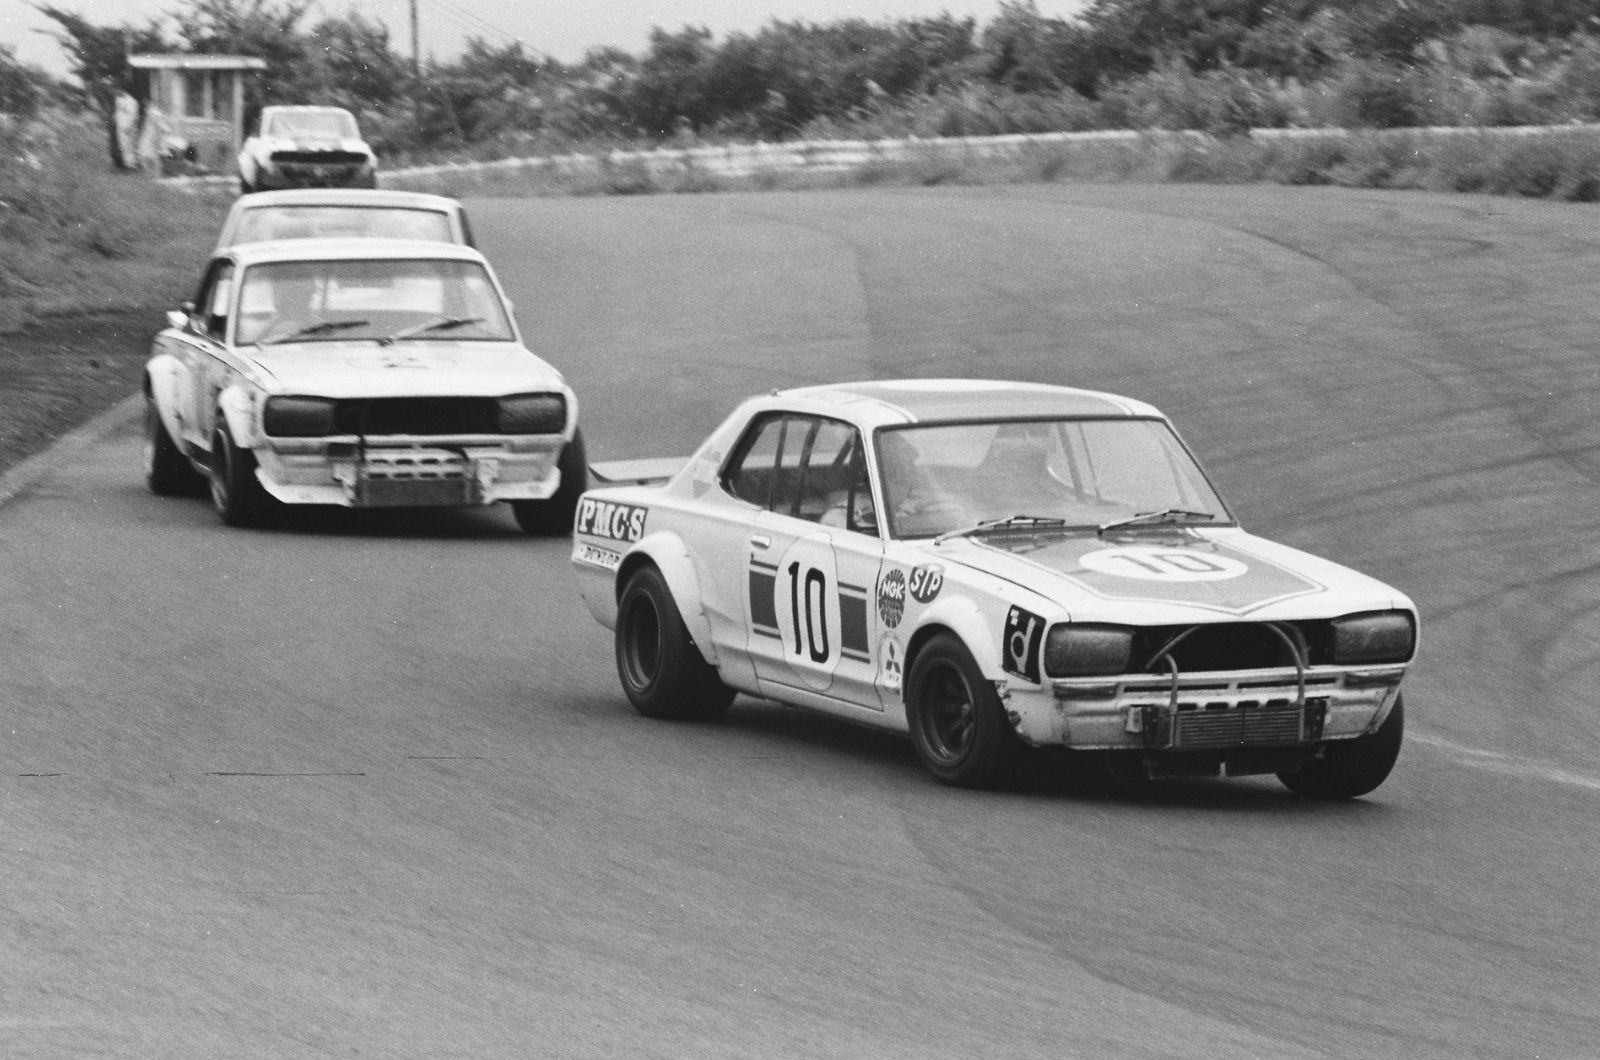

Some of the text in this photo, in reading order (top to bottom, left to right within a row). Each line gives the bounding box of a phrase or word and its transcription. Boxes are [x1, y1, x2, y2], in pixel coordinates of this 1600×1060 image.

[1109, 554, 1227, 574] 10
[882, 580, 904, 600] NGK
[910, 564, 942, 598] STP
[788, 561, 829, 664] 10
